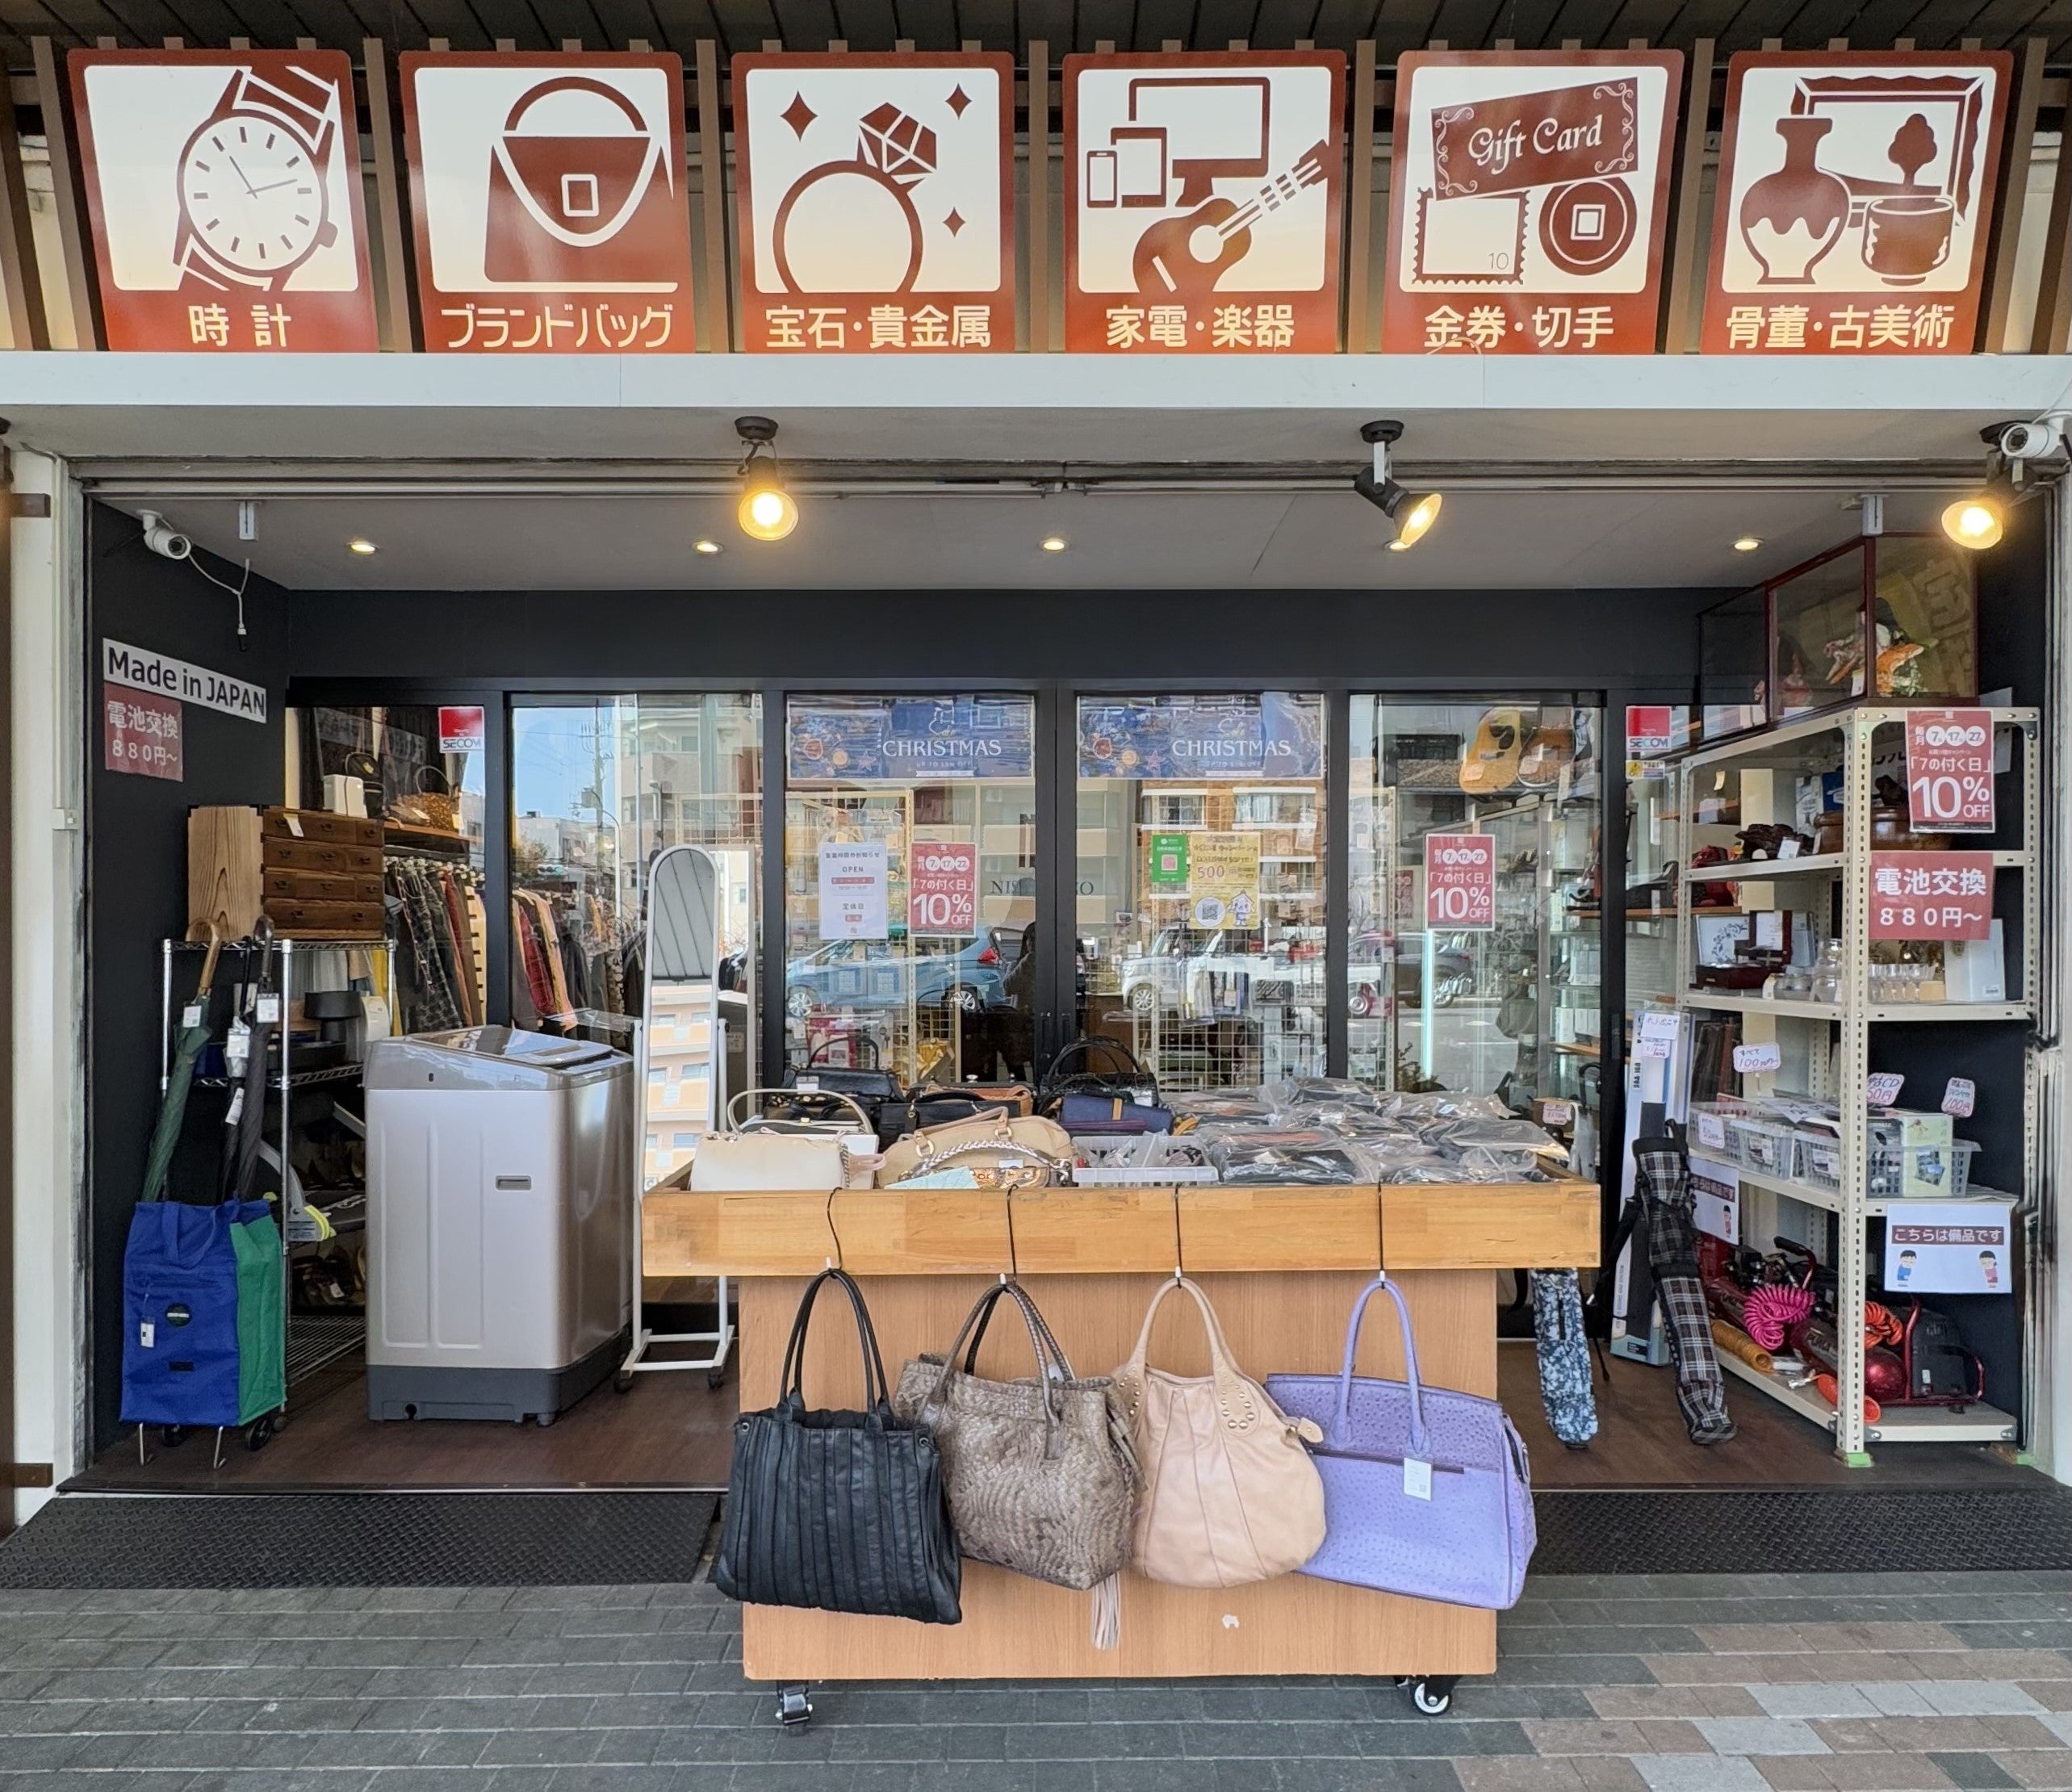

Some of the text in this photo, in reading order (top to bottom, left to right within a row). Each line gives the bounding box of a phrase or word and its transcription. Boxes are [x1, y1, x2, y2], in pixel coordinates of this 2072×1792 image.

[1468, 115, 1603, 174] Gift Card
[1488, 252, 1509, 270] 10
[188, 304, 292, 347] 時計
[441, 304, 673, 348] ブランドバッグ
[765, 304, 992, 348] 宝石・貴金属
[1105, 304, 1295, 348] 家電・楽器
[1425, 304, 1614, 349] 金券・切手
[1726, 304, 1955, 349] 骨董・古美術
[108, 647, 266, 717] Made in JAPAN
[107, 700, 178, 739] 電池交換
[442, 738, 482, 749] SECOM
[882, 739, 1003, 757] CHRISTMAS
[1171, 739, 1291, 757] CHRISTMAS
[1629, 737, 1668, 748] SECOM
[1962, 804, 1990, 819] OFF
[1197, 865, 1225, 879] 500
[1875, 867, 1987, 896] 電池交換
[951, 914, 973, 925] OFF
[1469, 907, 1490, 919] OFF
[1894, 1228, 2003, 1243] こちらは備品です
